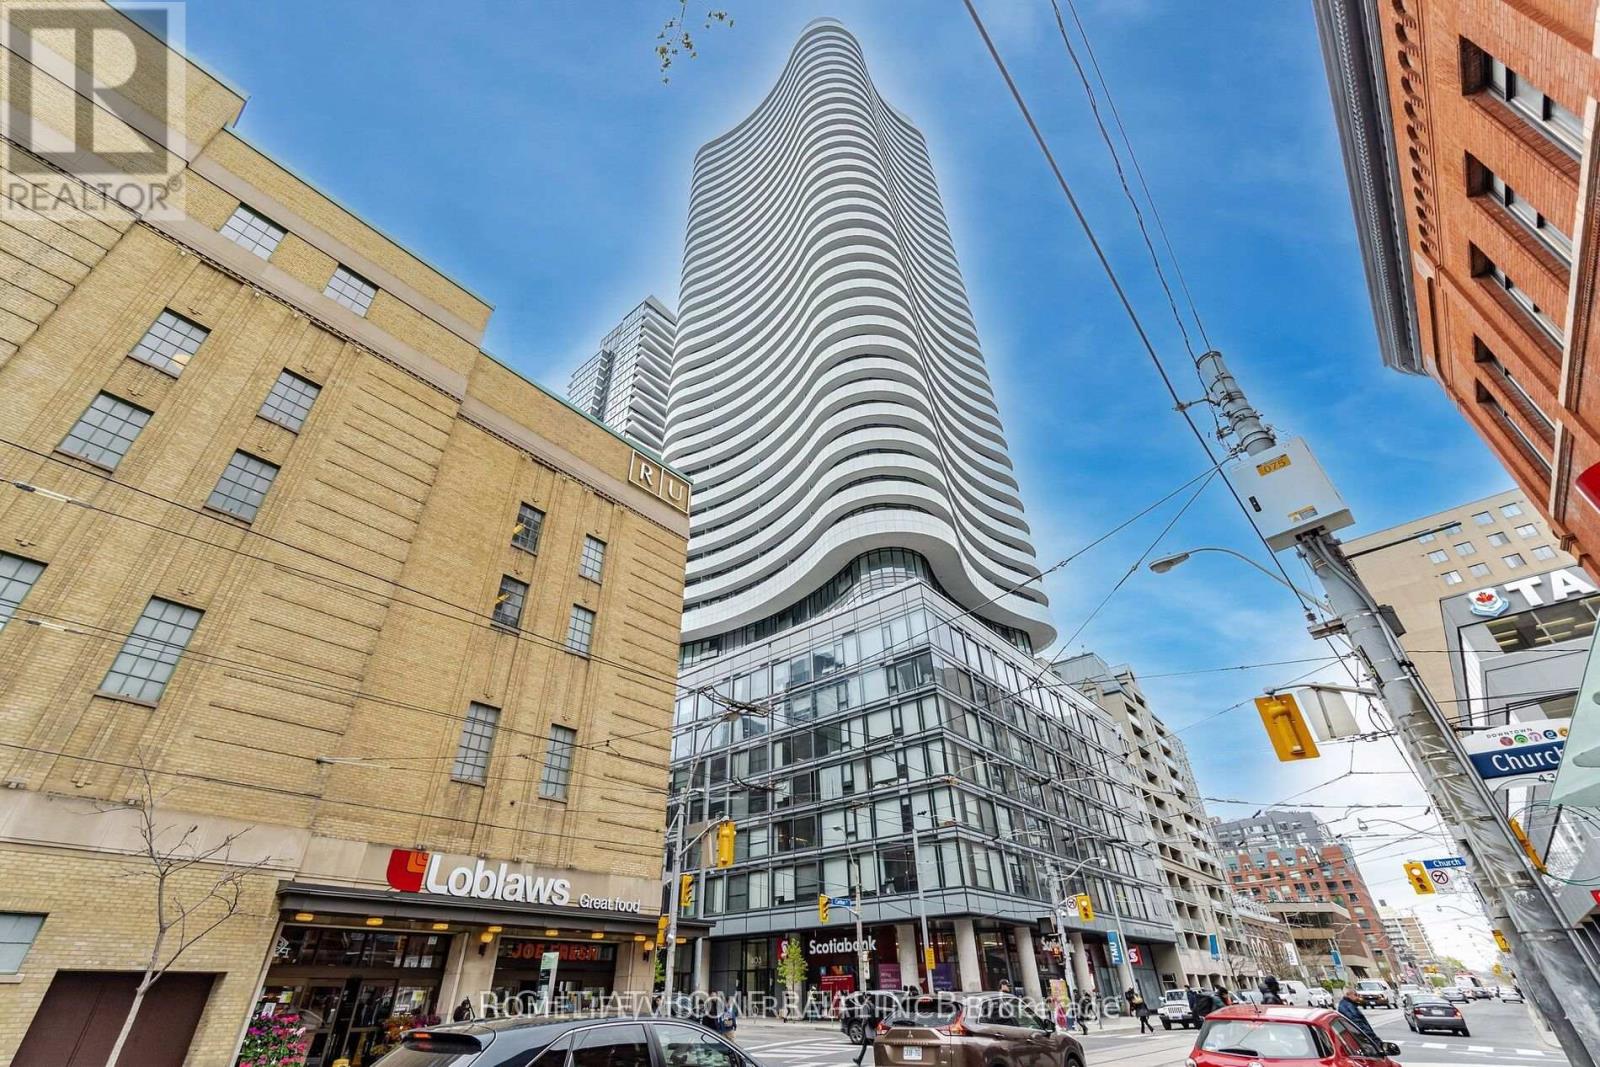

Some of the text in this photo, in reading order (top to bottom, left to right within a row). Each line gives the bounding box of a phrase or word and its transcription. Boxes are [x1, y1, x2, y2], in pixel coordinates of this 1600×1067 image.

[1486, 728, 1533, 738] DOWNTOWN
[1433, 859, 1461, 867] Church
[426, 854, 571, 906] Loblaws
[578, 893, 641, 913] Great food
[809, 935, 877, 955] Scotiabank
[1109, 942, 1120, 965] TMU
